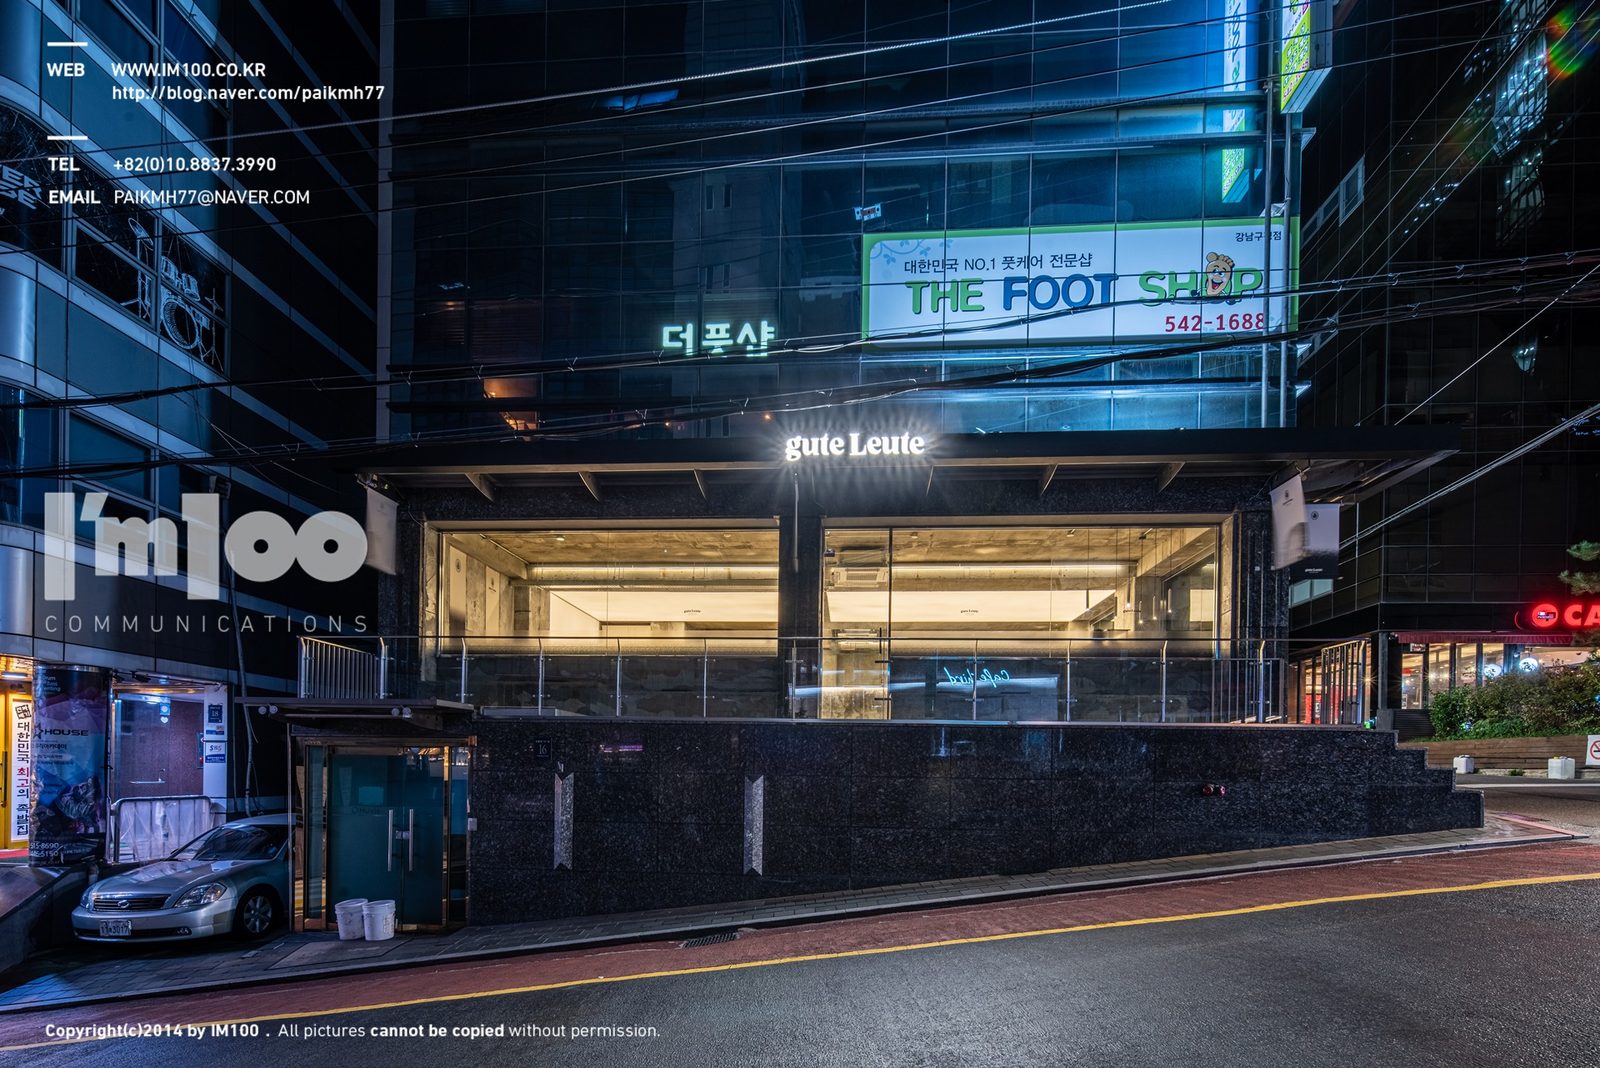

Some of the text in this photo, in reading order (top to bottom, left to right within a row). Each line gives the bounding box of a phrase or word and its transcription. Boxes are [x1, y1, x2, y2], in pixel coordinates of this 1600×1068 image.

[1235, 231, 1282, 243] 강남구점
[904, 252, 1093, 274] 대한민국 NO.1 풋케어 전문샵
[905, 277, 985, 315] THE
[1002, 273, 1120, 311] FOOT
[1164, 314, 1265, 333] 542-1688
[785, 432, 925, 462] gute Leute
[16, 722, 30, 764] 대한민국
[44, 728, 89, 737] HOUSE
[16, 766, 30, 799] 최고의
